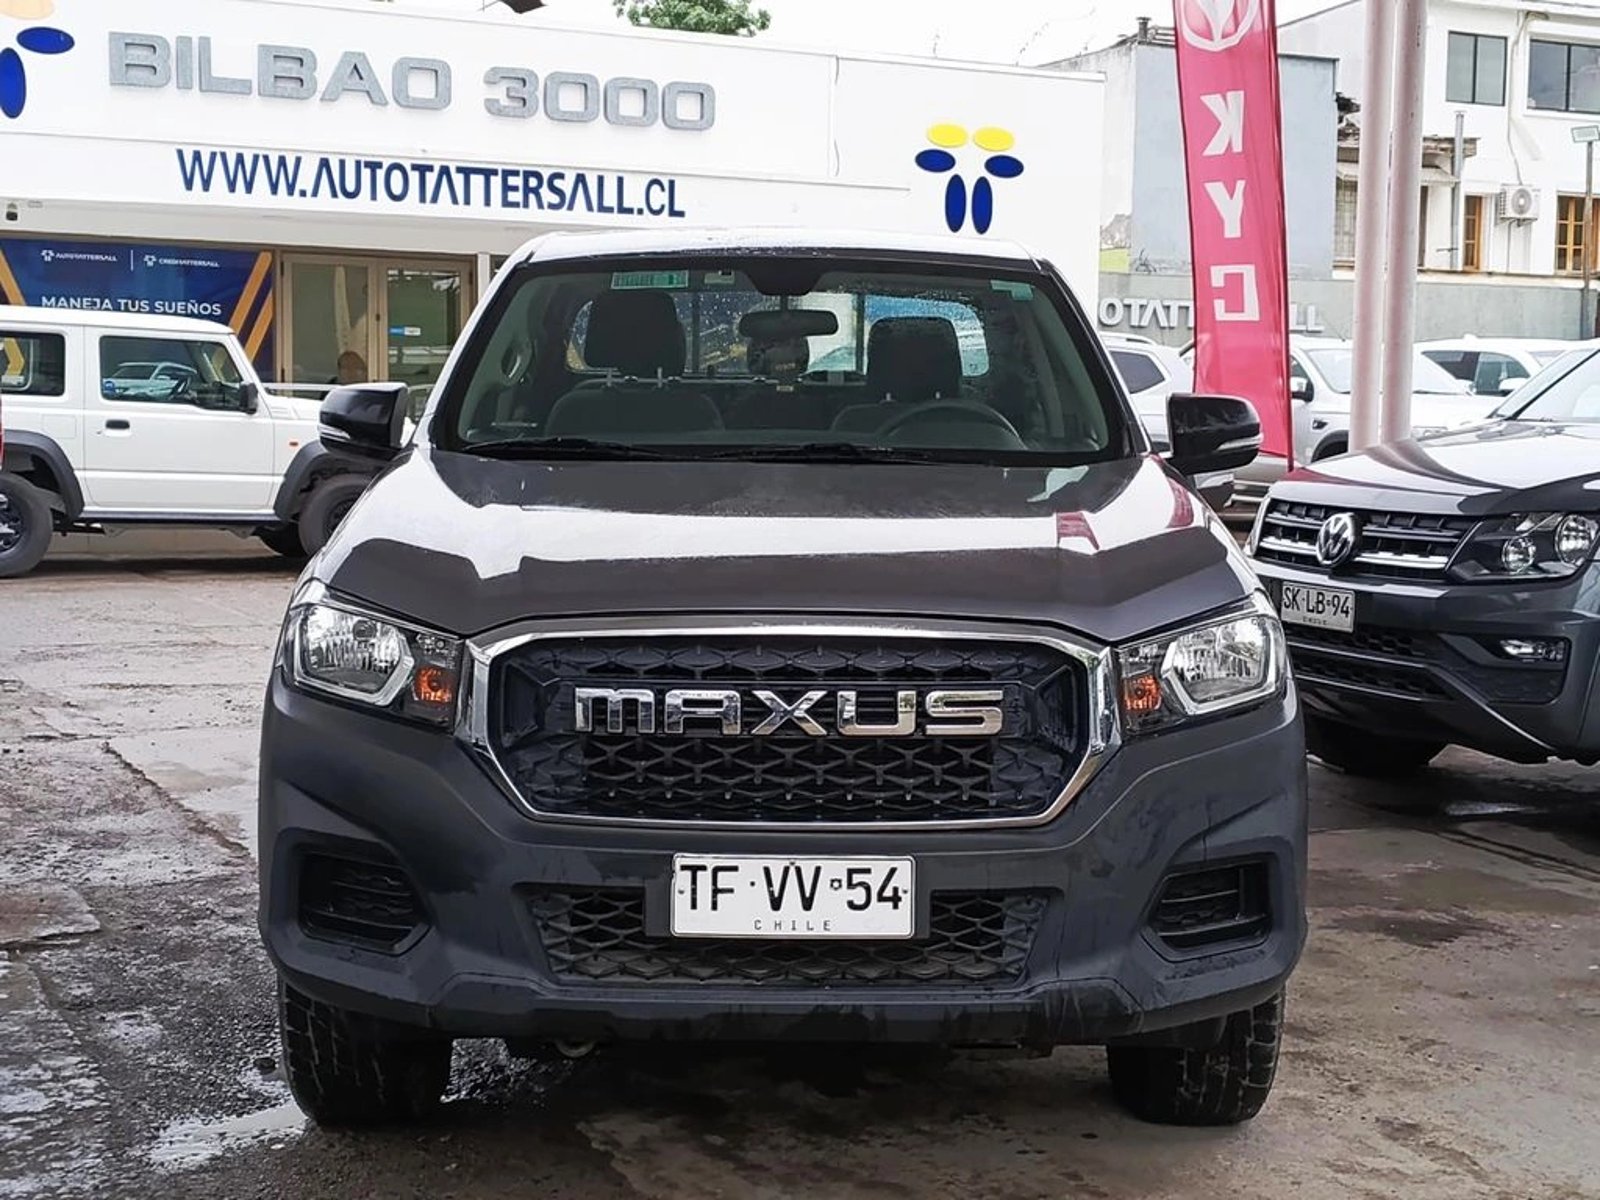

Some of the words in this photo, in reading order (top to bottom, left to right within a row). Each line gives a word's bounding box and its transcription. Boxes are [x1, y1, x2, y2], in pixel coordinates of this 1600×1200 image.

[108, 31, 453, 112] BILBAO
[482, 66, 717, 132] 3000
[176, 148, 687, 218] WWW.AUTOTATTERSALL.CL
[41, 296, 113, 311] MANEJA
[118, 299, 150, 313] TUS
[154, 299, 223, 316] SUEÑOS
[574, 686, 1005, 737] MAXUS
[753, 919, 832, 932] CHILE
